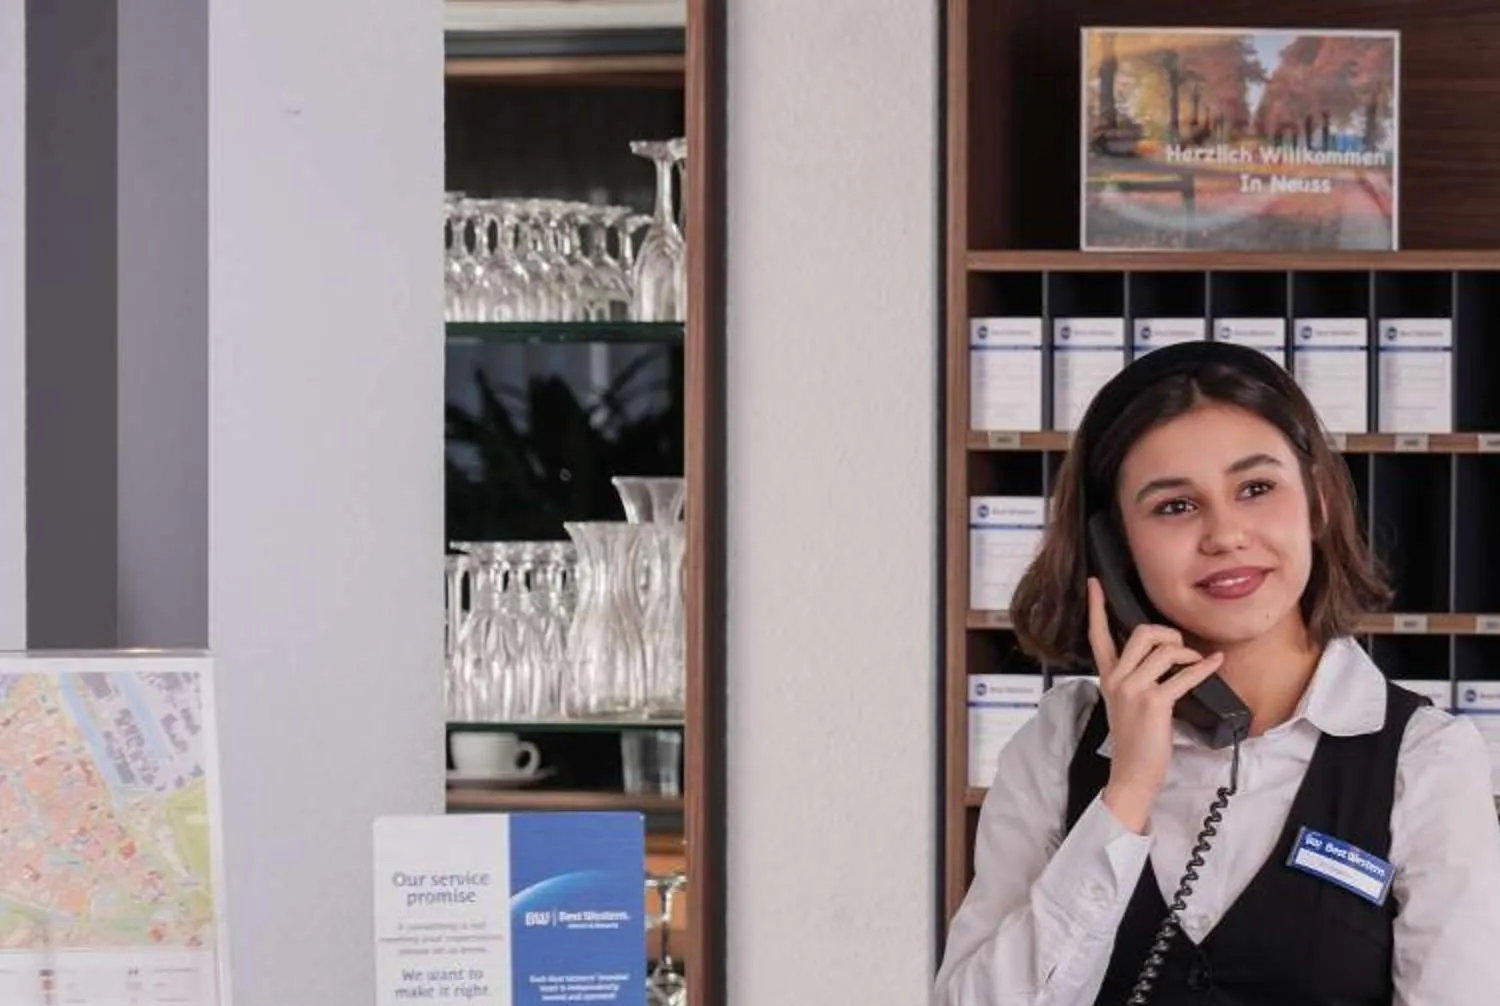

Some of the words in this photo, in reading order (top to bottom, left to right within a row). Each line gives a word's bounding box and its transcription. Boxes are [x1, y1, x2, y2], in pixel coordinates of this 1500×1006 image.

[1166, 144, 1252, 163] Herzlich
[1259, 146, 1387, 166] Willkommen
[1240, 174, 1262, 193] In
[1270, 175, 1331, 194] Neuss
[392, 871, 426, 887] Our
[431, 870, 490, 886] service
[407, 888, 477, 906] promise
[402, 968, 424, 981] We
[427, 969, 465, 981] want
[394, 984, 436, 999] make
